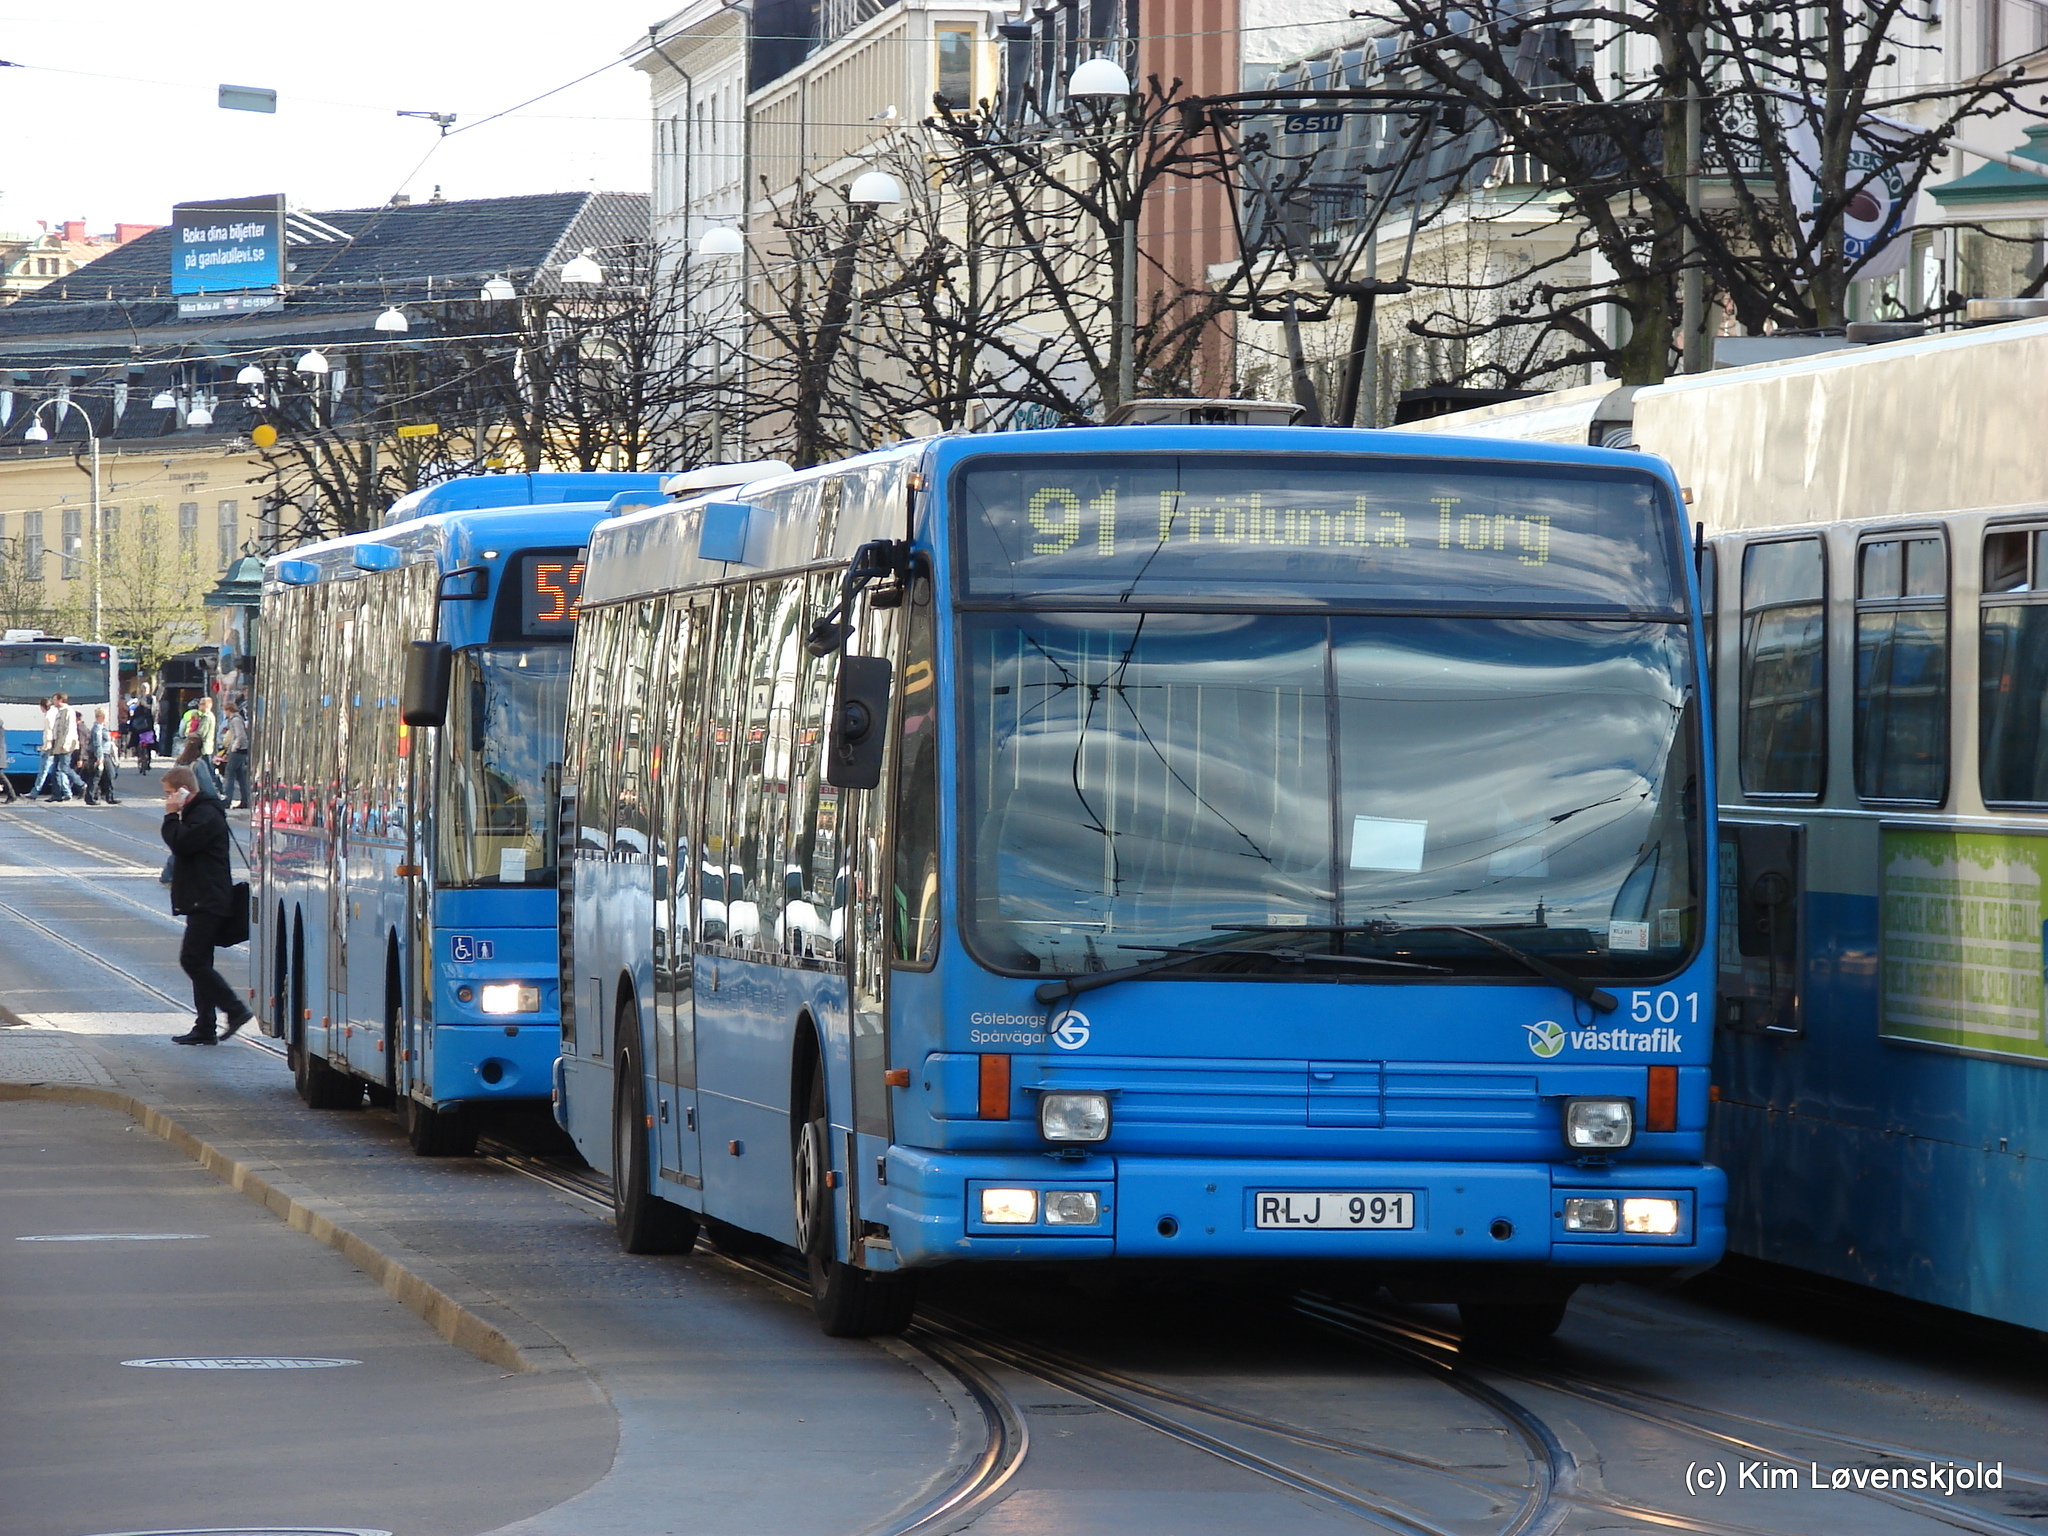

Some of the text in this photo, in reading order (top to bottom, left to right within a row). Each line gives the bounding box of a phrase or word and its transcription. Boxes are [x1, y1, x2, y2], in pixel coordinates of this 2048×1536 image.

[1288, 115, 1339, 132] 6511
[182, 222, 266, 243] Boka dina biljetter
[185, 246, 265, 270] på gamlaullevi.se
[1028, 487, 1550, 567] 91 Frölunda Torg
[1631, 990, 1699, 1023] 501
[970, 1012, 1047, 1028] Göteborgs
[970, 1029, 1047, 1046] Spårvägar
[1570, 1025, 1682, 1053] västtrafik
[1262, 1197, 1403, 1224] RLJ 991
